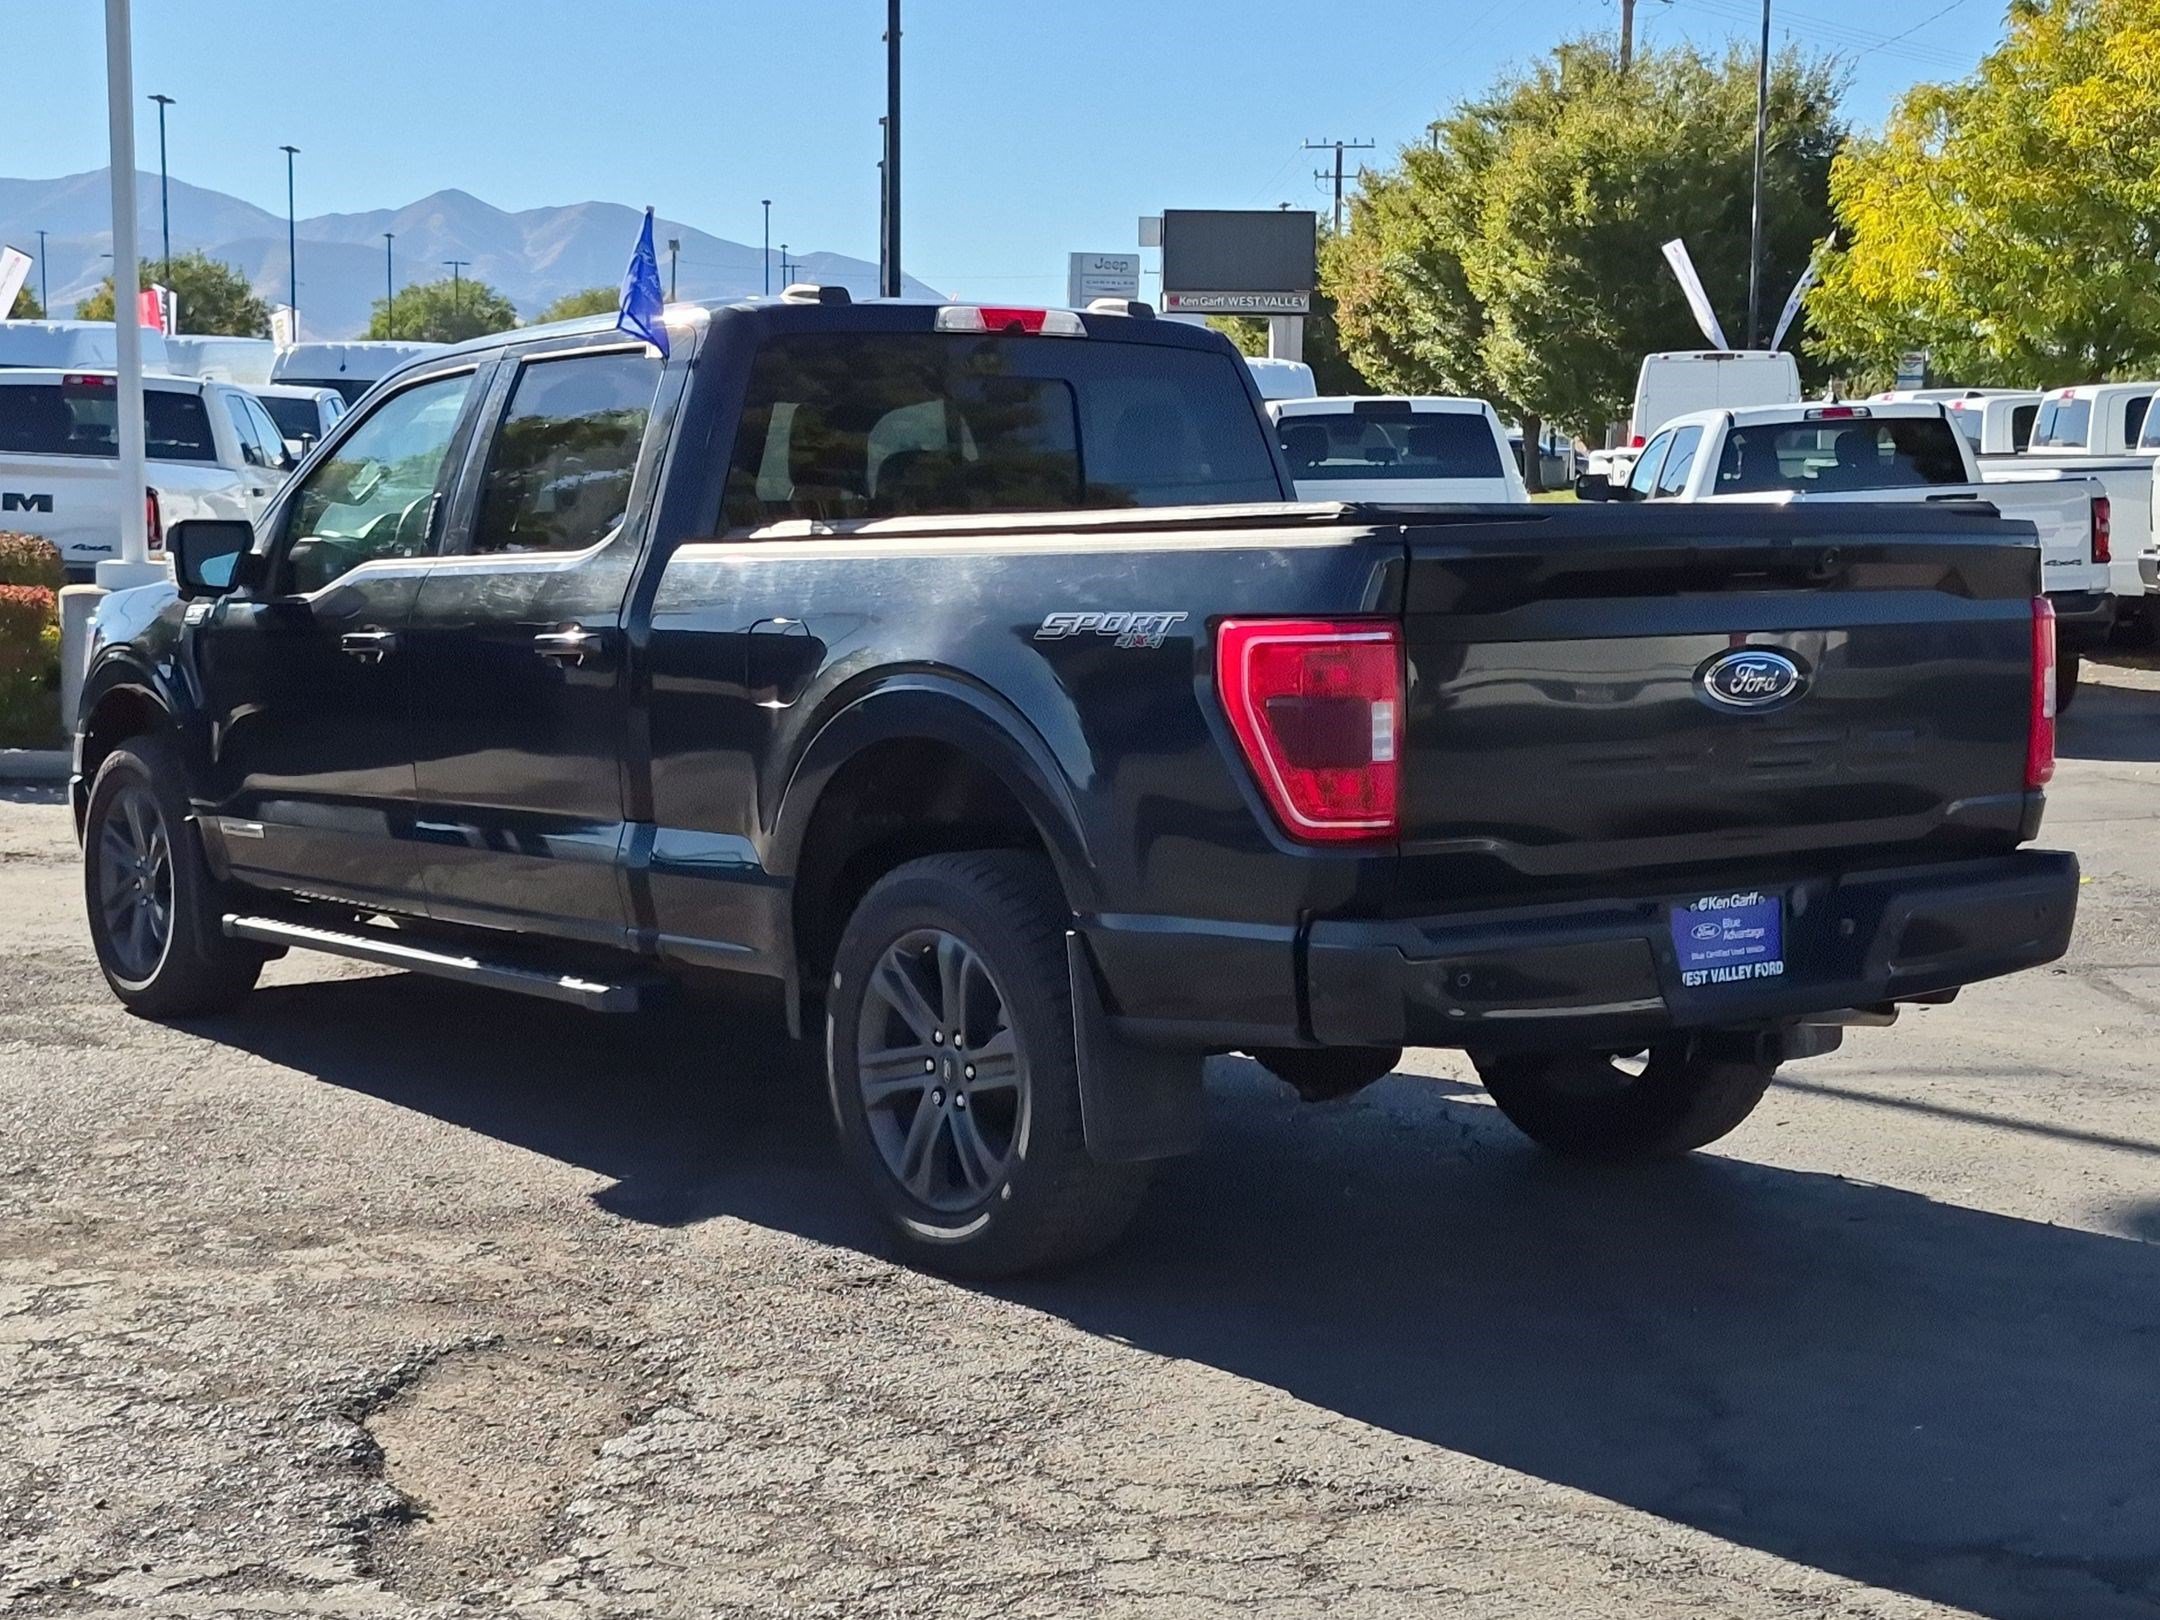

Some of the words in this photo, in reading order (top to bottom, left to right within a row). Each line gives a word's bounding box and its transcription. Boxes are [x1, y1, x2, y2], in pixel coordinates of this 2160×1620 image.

[1094, 257, 1129, 273] Jeep
[1179, 296, 1199, 306] Ken
[1200, 296, 1225, 306] Garff
[1228, 296, 1260, 307] WEST
[1263, 296, 1307, 307] VALLEY
[1033, 611, 1189, 641] SPORT
[1729, 662, 1780, 695] Ford
[1708, 896, 1730, 910] Ken
[1730, 891, 1758, 908] Garff
[1722, 917, 1741, 929] Blue
[1710, 964, 1753, 983] VALLEY
[1754, 960, 1784, 978] FORD
